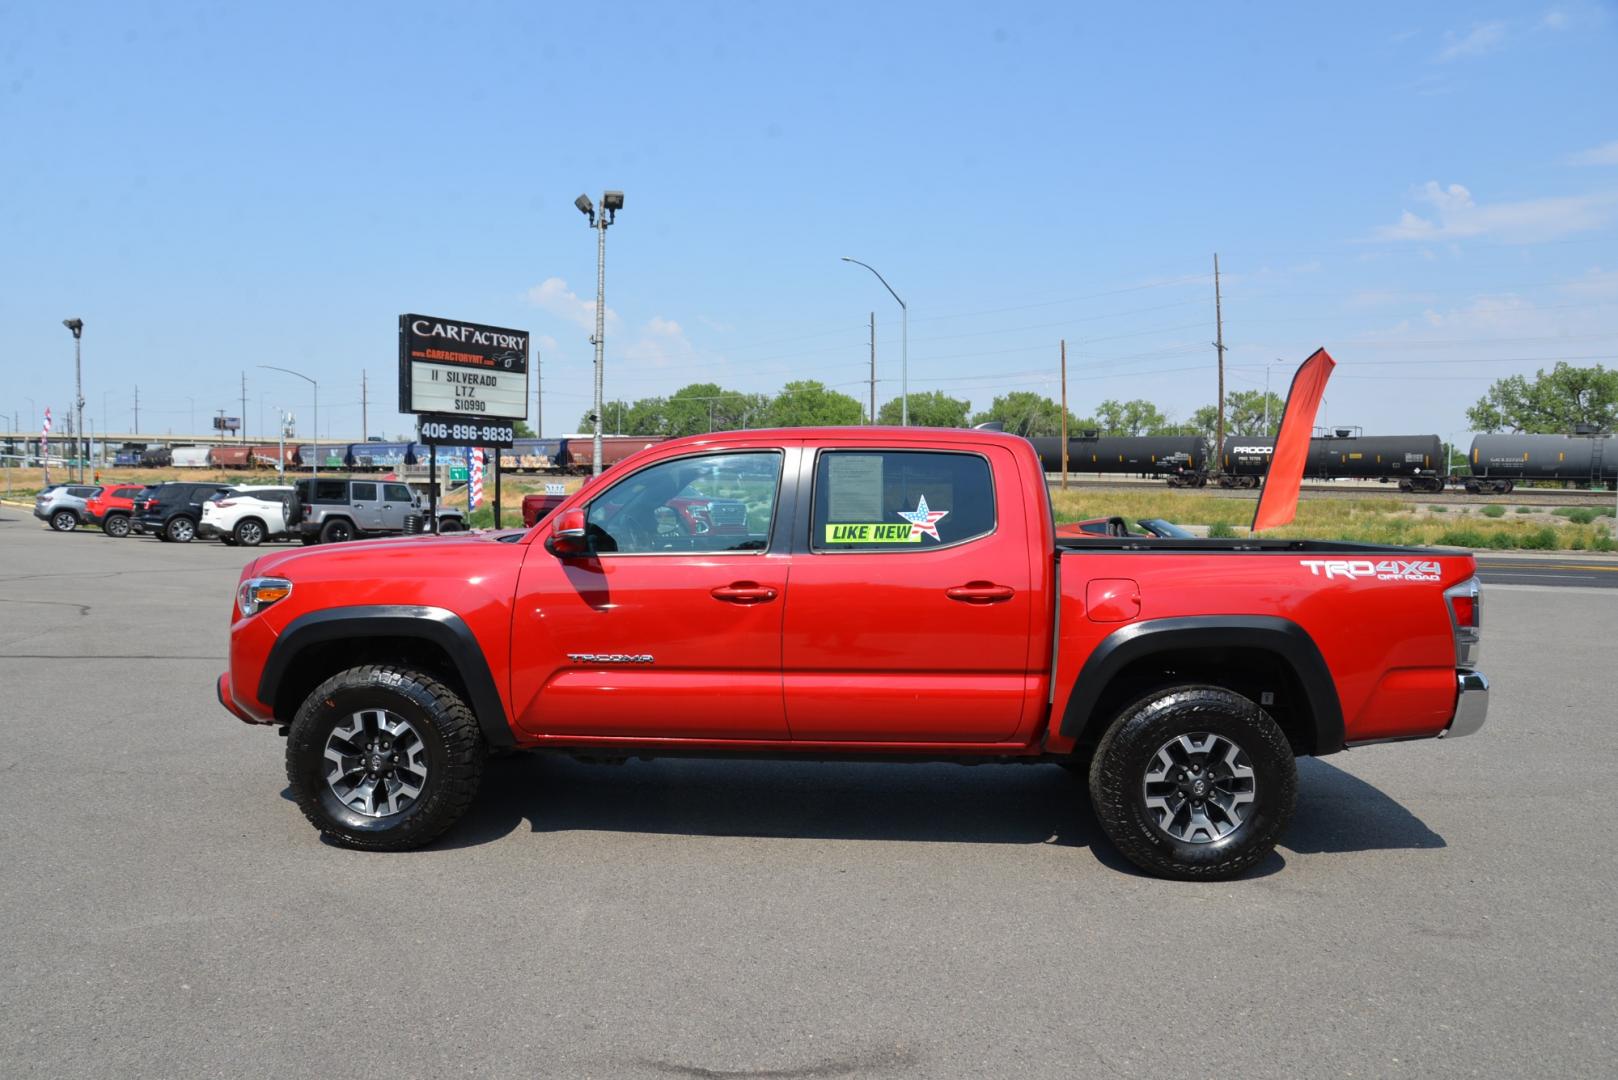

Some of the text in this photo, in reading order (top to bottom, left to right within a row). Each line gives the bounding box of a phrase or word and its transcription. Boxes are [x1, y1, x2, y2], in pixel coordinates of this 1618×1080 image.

[446, 371, 497, 387] SILVERADO
[455, 386, 475, 397] LTZ
[421, 422, 513, 442] 406-896-9833
[832, 526, 912, 539] LIKE NEW
[1299, 560, 1377, 580] TRD
[1377, 573, 1403, 581] OFF
[567, 653, 654, 663] TACOMA
